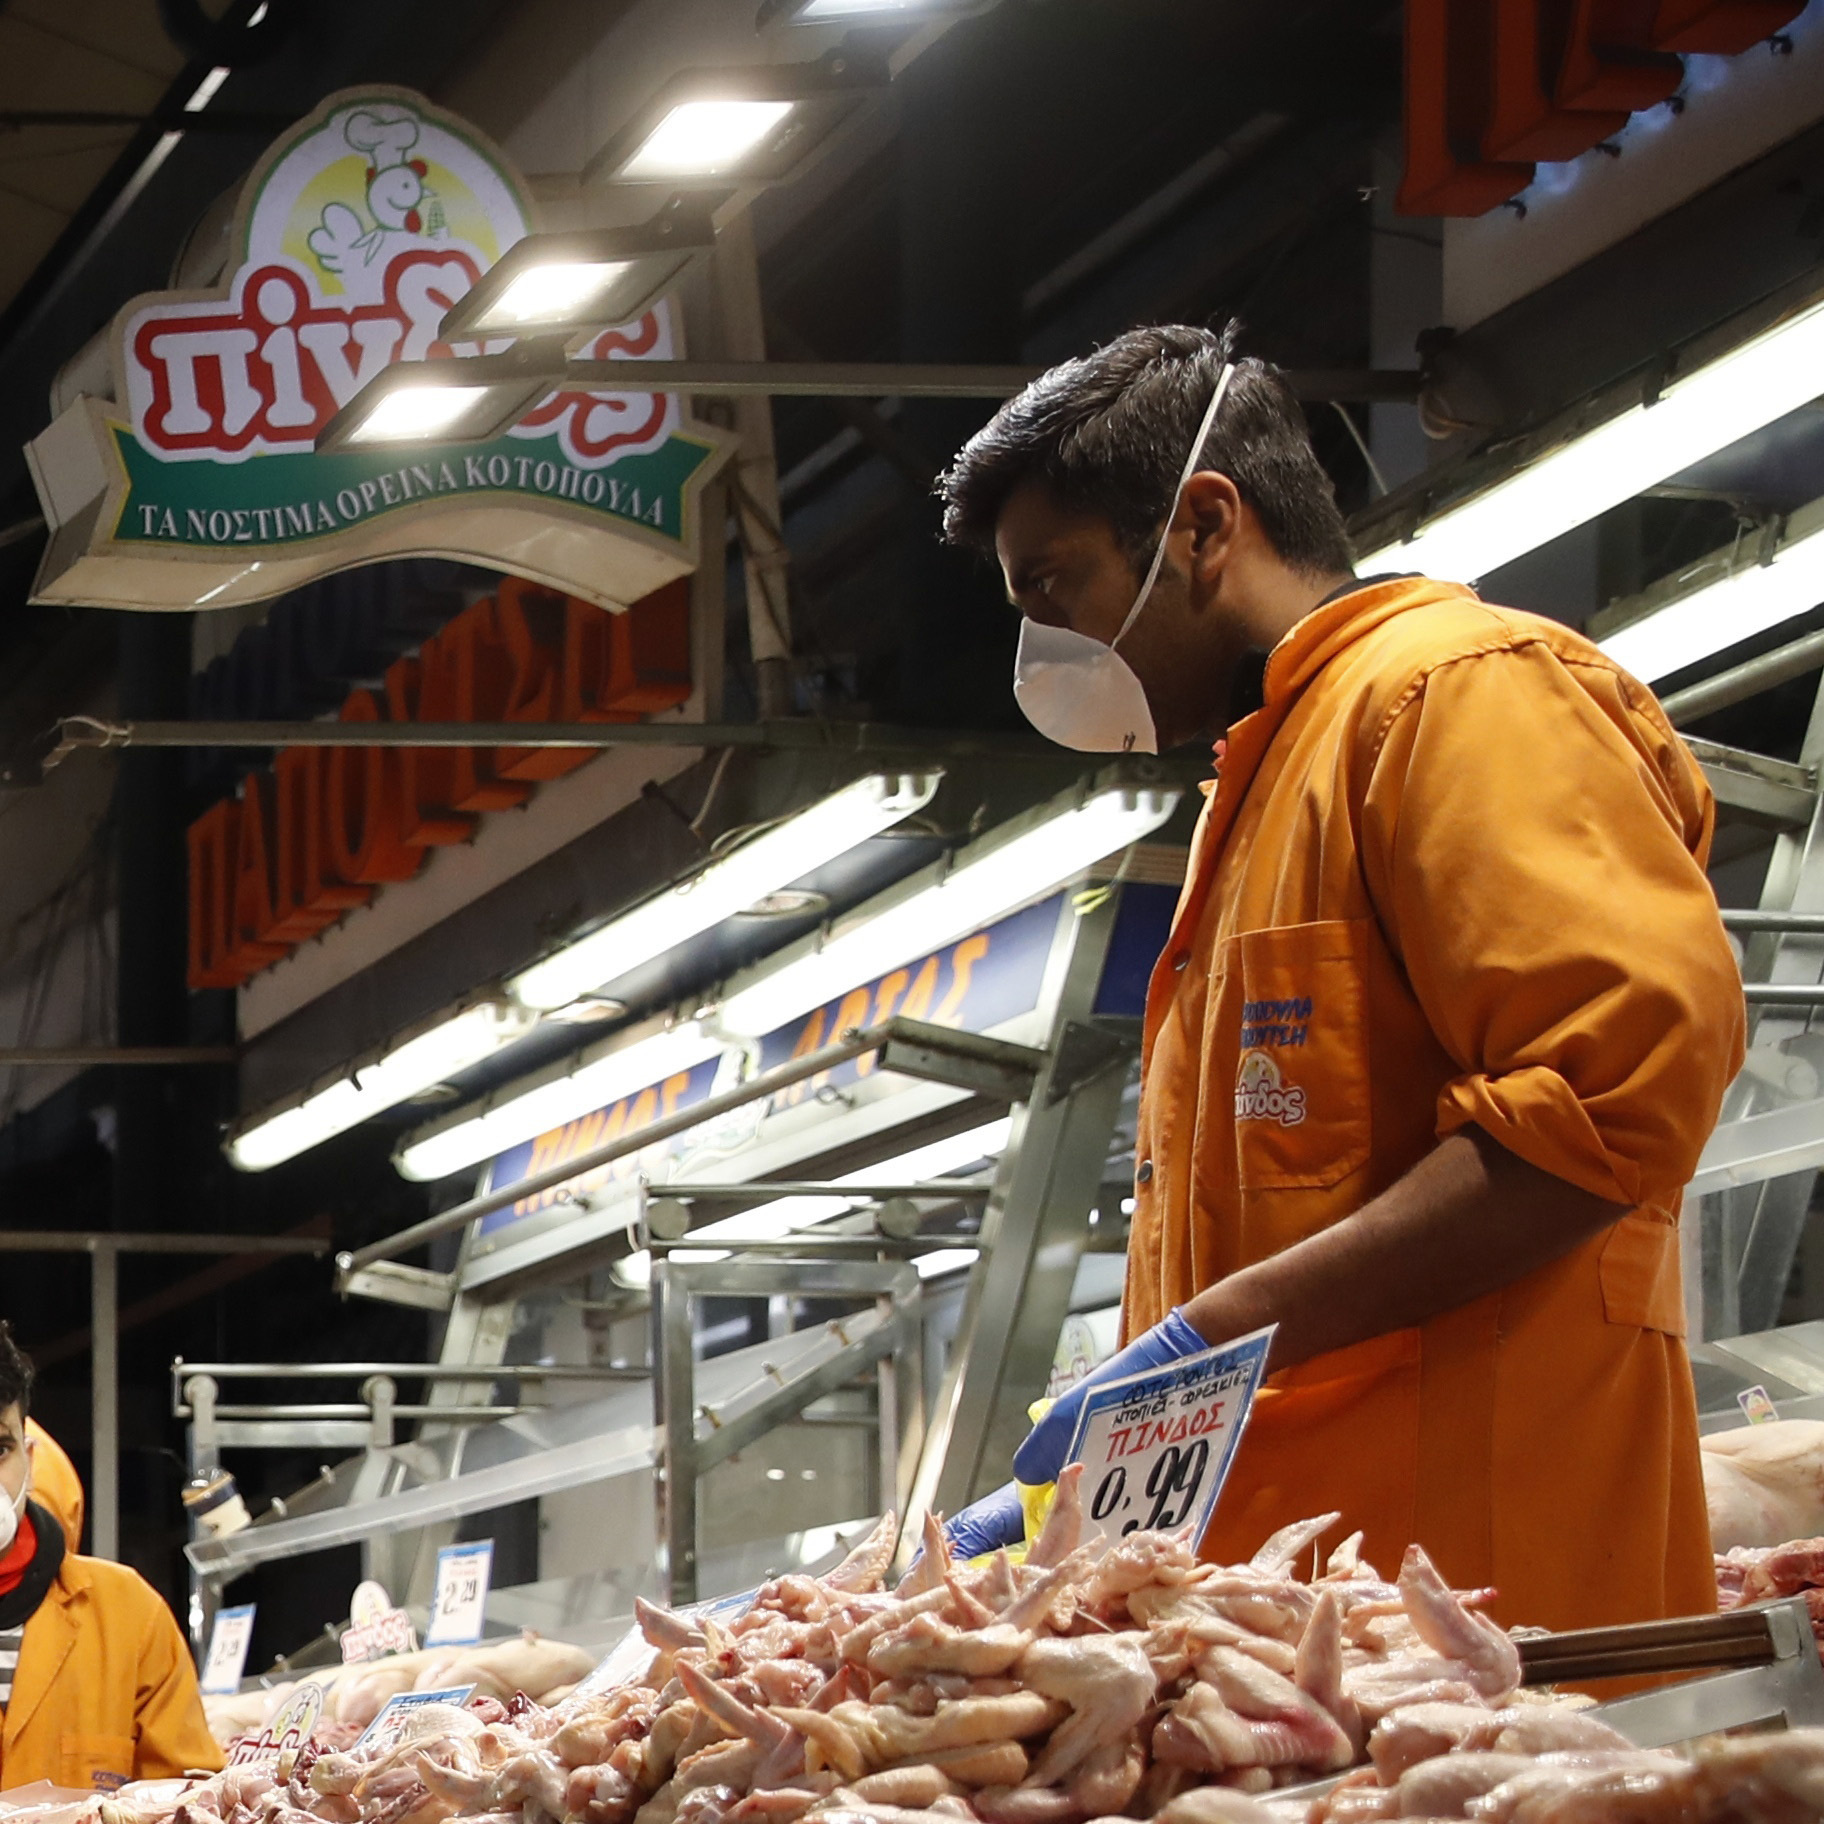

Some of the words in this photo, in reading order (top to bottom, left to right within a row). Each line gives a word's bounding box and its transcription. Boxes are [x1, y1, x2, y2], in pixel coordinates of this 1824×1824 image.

[138, 504, 179, 540] ΤΑ
[185, 500, 338, 542] ΝΟΣΤΙΜΑ
[336, 463, 458, 523] ΟΡΕΙΝΑ
[463, 454, 666, 528] ΚΟΤΟΠΟΥΛΑ
[1106, 1401, 1226, 1462] ΠΙΝΔΟΣ
